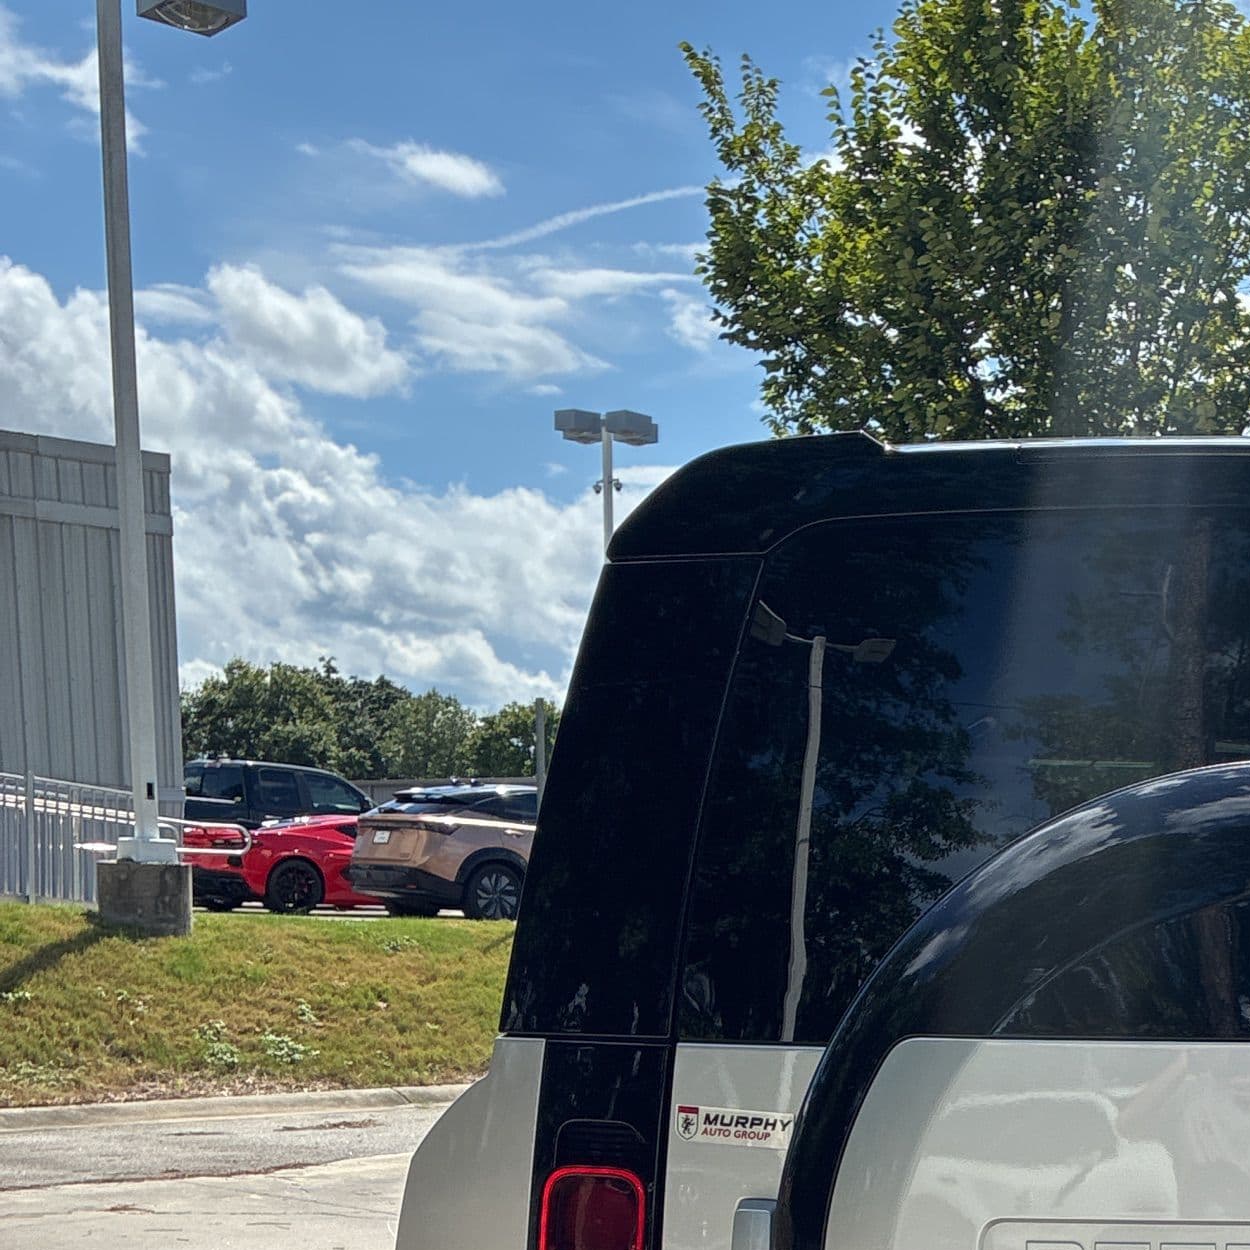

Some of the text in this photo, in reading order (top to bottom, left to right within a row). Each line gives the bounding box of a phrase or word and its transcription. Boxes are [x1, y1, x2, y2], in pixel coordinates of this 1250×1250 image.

[703, 1113, 793, 1132] MURPHY
[701, 1127, 771, 1141] AUTO GROUP
